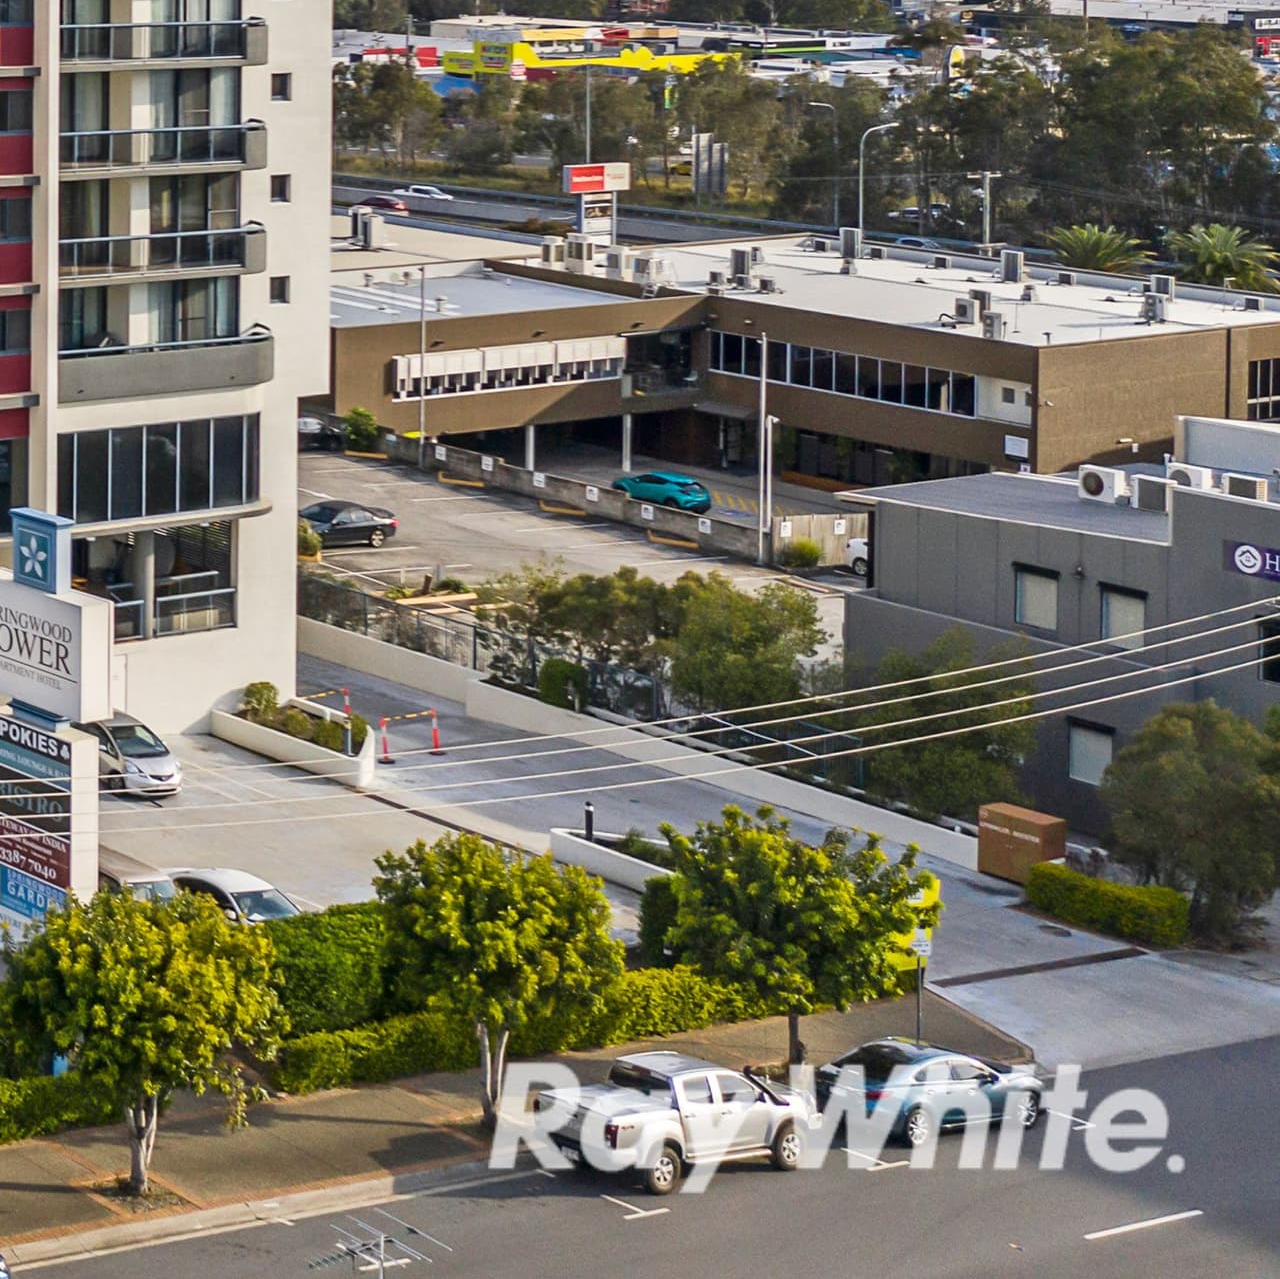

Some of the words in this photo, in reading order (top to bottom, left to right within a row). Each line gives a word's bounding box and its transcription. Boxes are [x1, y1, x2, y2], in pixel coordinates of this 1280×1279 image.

[37, 672, 62, 690] HOTEL
[0, 719, 58, 757] POKIES
[42, 835, 67, 853] INDIA
[0, 846, 27, 869] 3387
[27, 858, 57, 880] 7040
